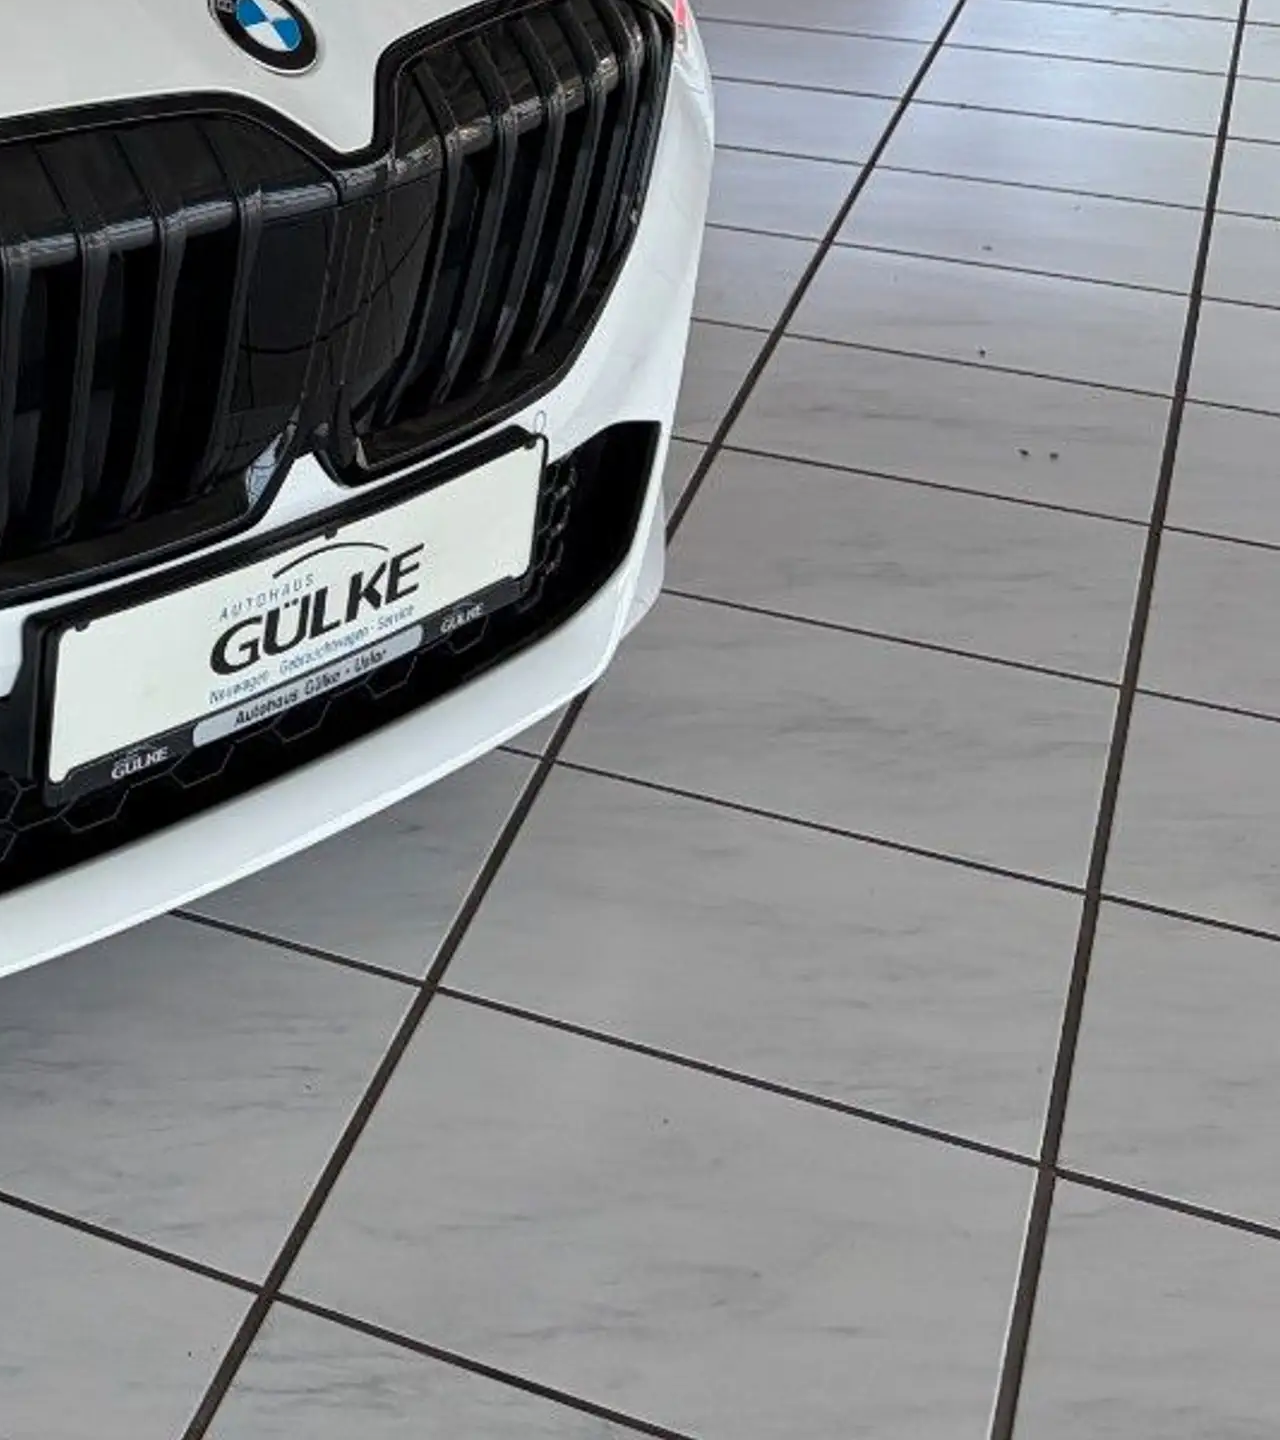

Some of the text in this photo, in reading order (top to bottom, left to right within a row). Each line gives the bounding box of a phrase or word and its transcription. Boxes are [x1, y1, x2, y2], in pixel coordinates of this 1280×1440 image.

[209, 542, 425, 676] GÜLKE
[219, 573, 315, 621] AUTOHAUS
[235, 689, 299, 727] Autohaus
